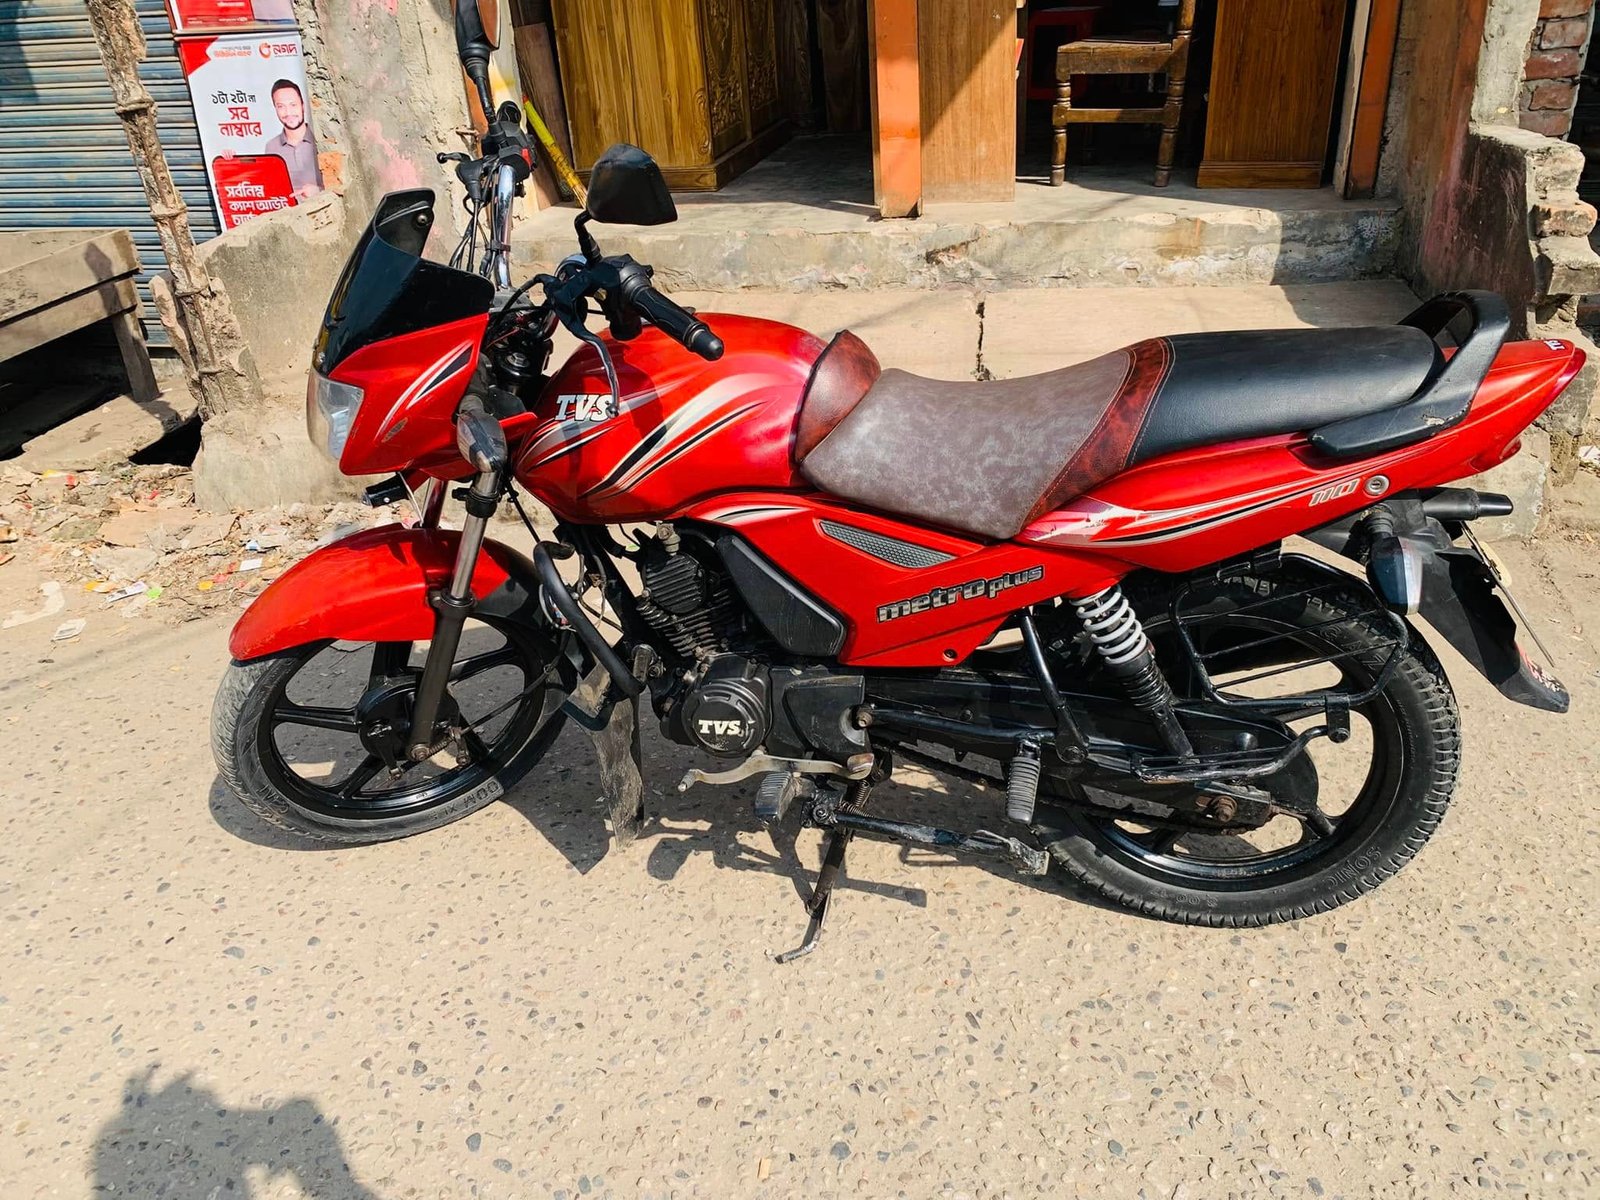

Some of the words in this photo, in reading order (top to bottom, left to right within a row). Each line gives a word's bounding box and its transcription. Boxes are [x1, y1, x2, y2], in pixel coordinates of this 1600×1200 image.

[272, 43, 298, 55] নগদ
[211, 90, 229, 105] ১টা
[231, 90, 247, 104] ২টা
[228, 106, 250, 121] সব
[218, 122, 263, 138] নাম্বারে
[553, 394, 612, 422] TVS
[1308, 478, 1361, 507] 110
[877, 579, 988, 623] metro
[987, 565, 1044, 599] plus
[698, 719, 743, 736] TVS
